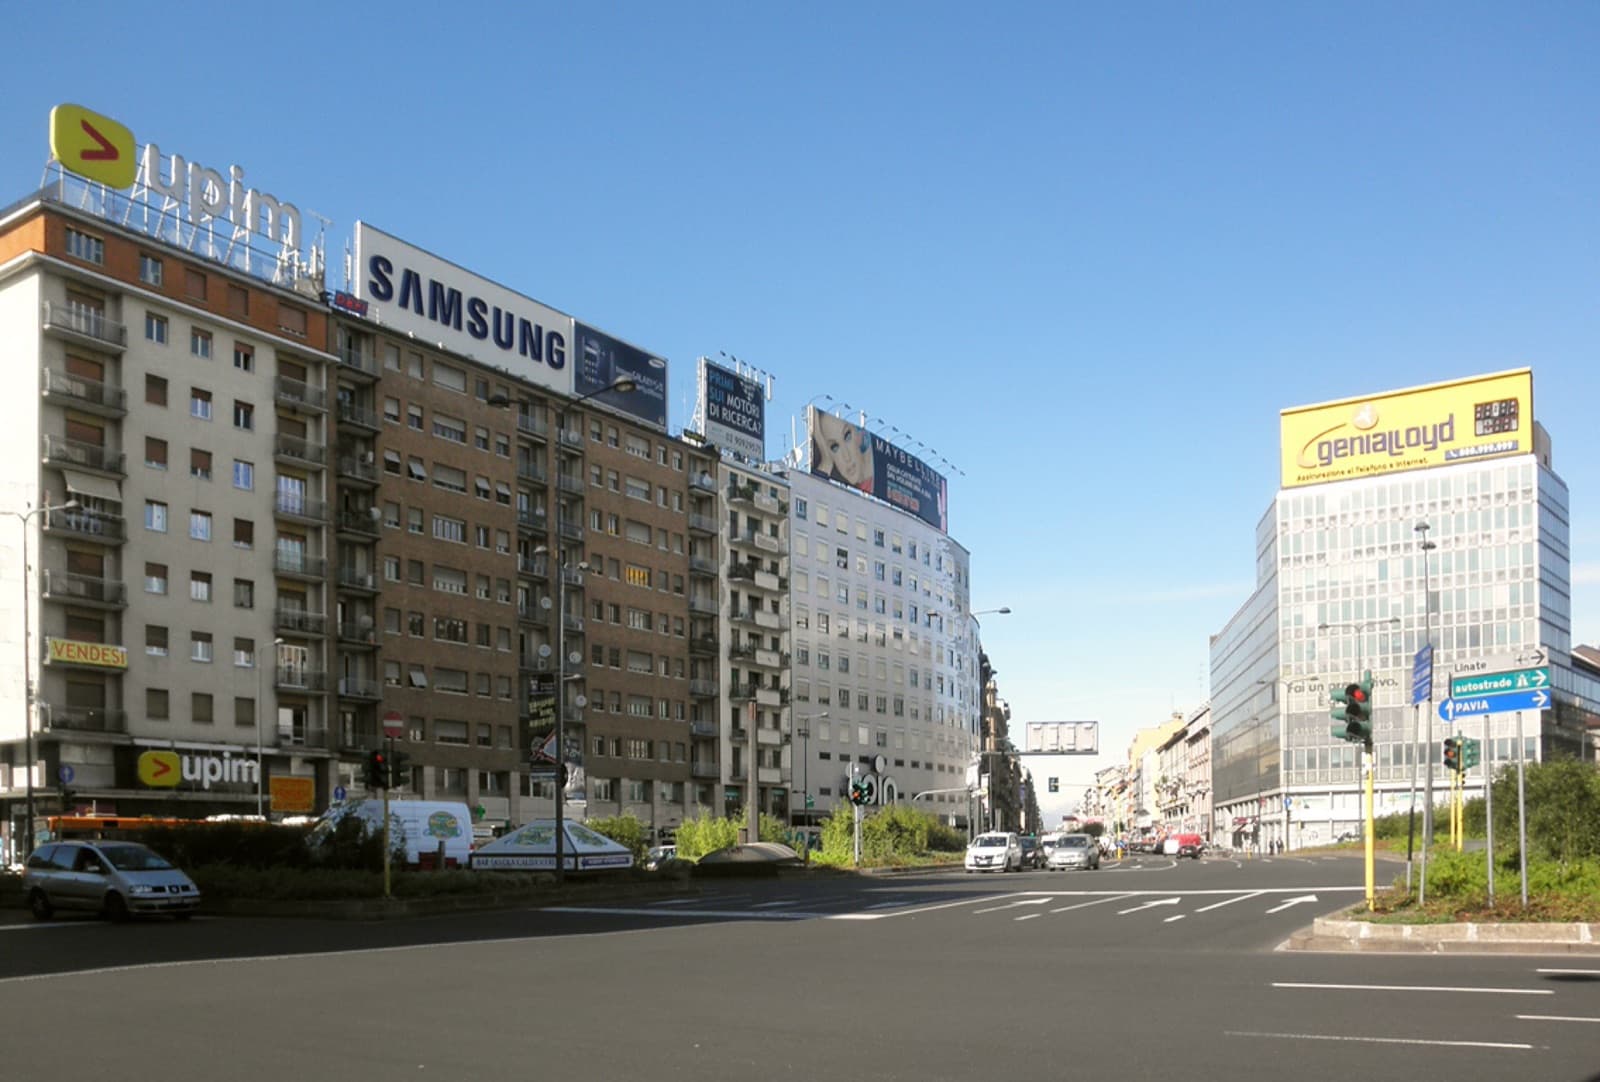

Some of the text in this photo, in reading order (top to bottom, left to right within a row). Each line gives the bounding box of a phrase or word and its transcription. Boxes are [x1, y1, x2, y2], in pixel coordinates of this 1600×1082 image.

[145, 143, 301, 249] upim
[368, 254, 566, 371] SAMSUNG
[709, 402, 762, 434] DI RICERCA?
[726, 393, 761, 419] MOTORI
[52, 640, 126, 666] VENDESI
[1454, 661, 1487, 672] Linate
[1309, 682, 1325, 692] un
[1455, 700, 1489, 712] PAVIA
[182, 751, 259, 790] upim
